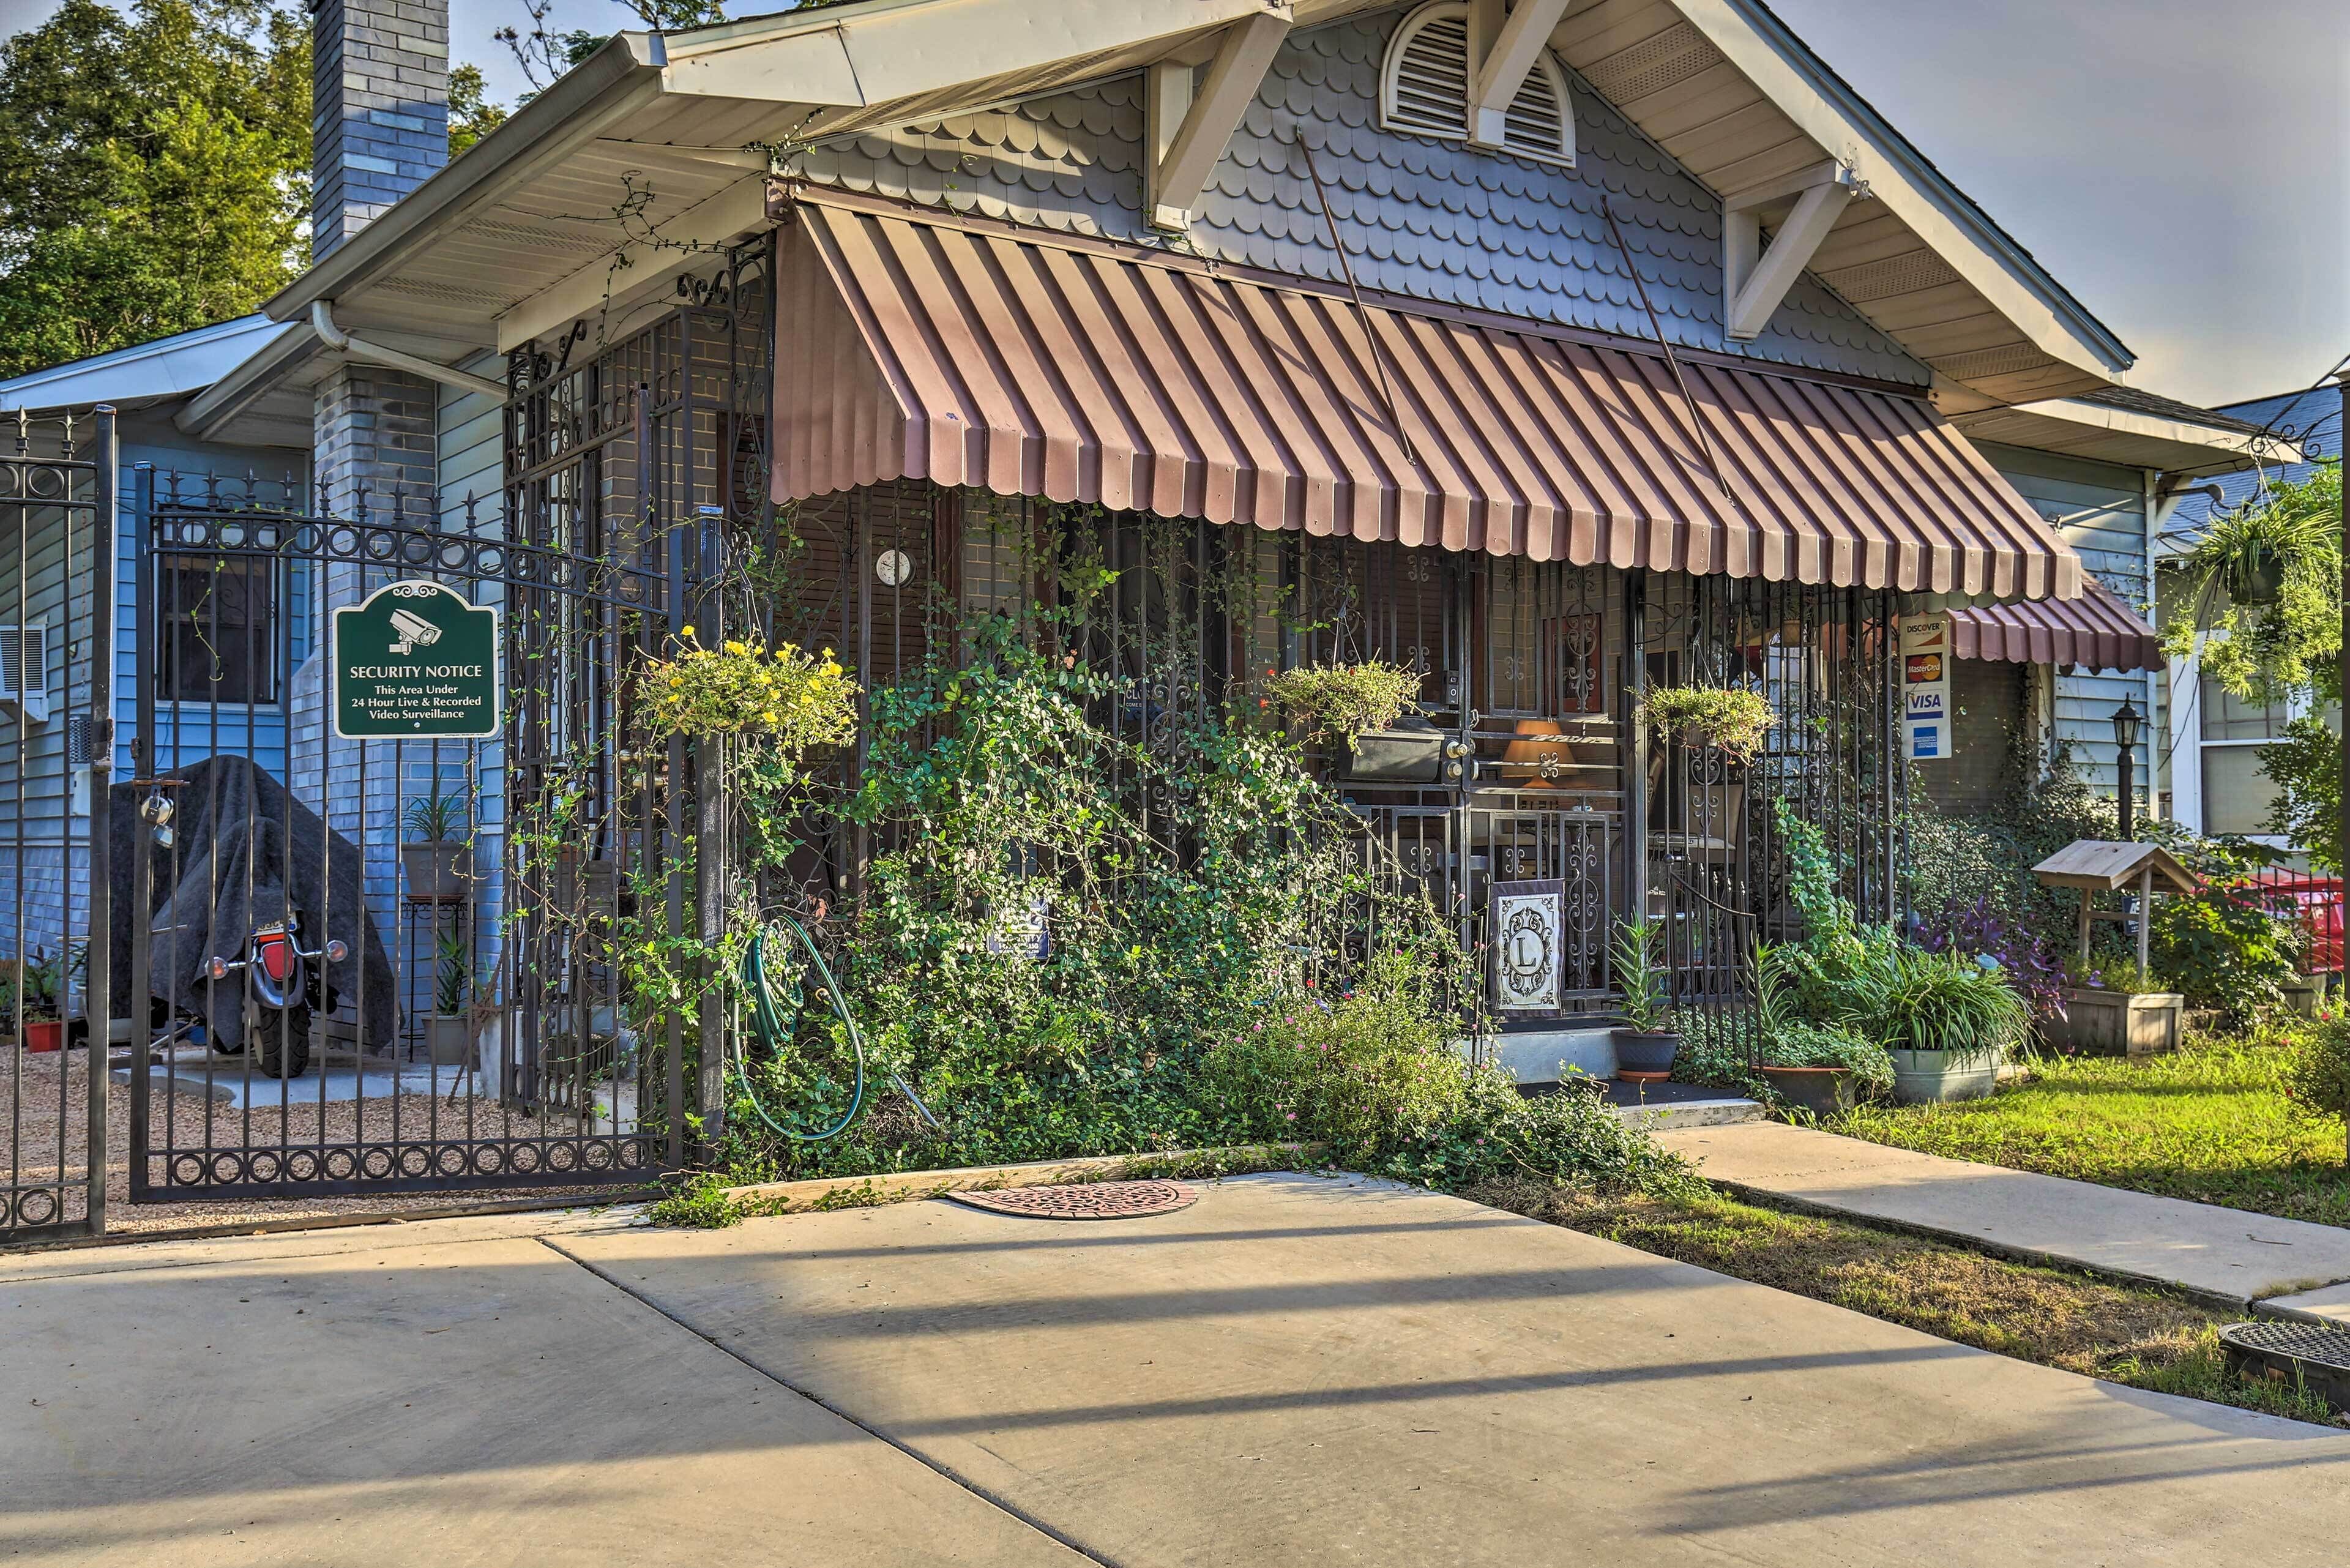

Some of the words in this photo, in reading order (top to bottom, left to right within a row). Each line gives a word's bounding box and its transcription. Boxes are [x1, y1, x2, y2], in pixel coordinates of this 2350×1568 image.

[1907, 623, 1939, 633] DISCOVER
[350, 666, 421, 679] SECURITY
[426, 665, 482, 678] NOTICE
[1908, 663, 1940, 673] MasterCard
[375, 685, 396, 695] This
[398, 685, 423, 695] Area
[426, 684, 458, 694] Under
[351, 698, 365, 707] 24
[368, 698, 395, 707] Hour
[398, 697, 419, 706] Live
[422, 698, 430, 706] &
[433, 696, 481, 706] Recorded
[1911, 694, 1941, 709] VISA
[370, 710, 399, 719] Video
[402, 709, 464, 719] Surveillance
[1516, 937, 1536, 967] L
